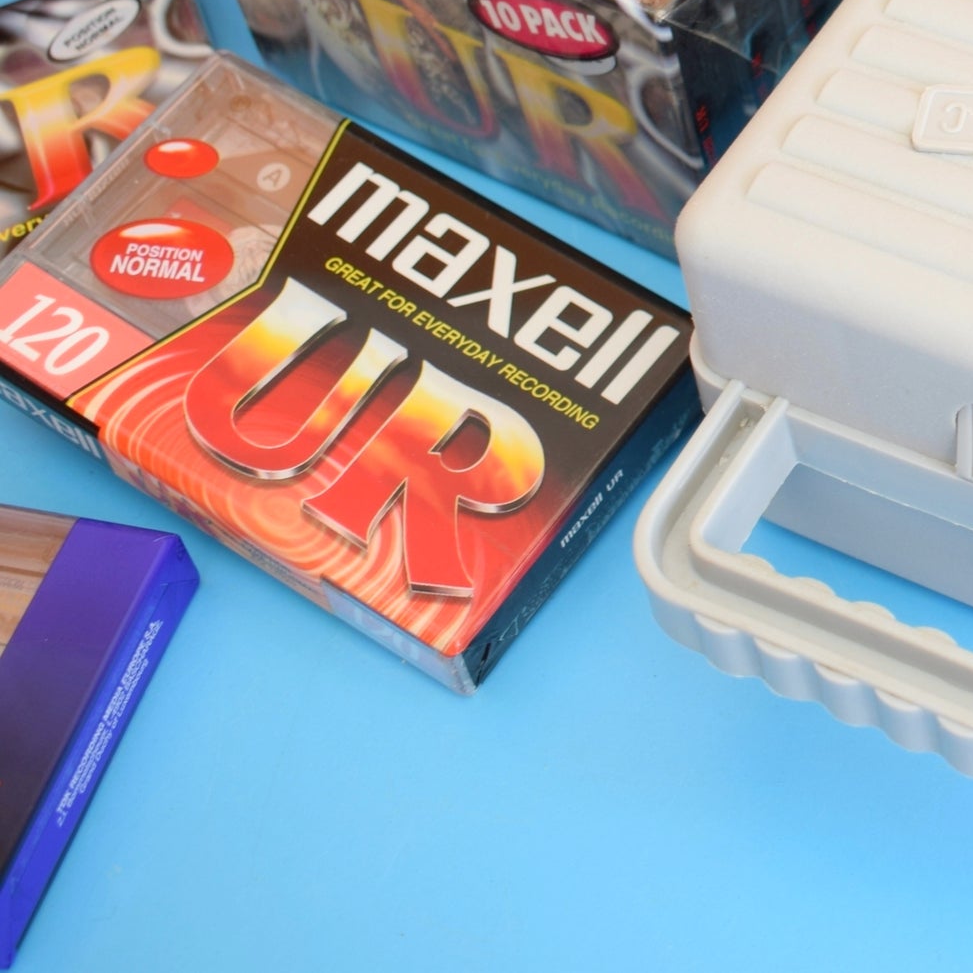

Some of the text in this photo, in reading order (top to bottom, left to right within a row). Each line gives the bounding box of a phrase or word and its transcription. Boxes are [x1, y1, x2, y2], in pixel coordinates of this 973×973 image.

[519, 3, 607, 45] PACK
[109, 254, 205, 282] NORMAL
[126, 243, 203, 262] POSITION
[307, 161, 680, 405] maxell
[0, 294, 110, 375] 120
[325, 257, 600, 430] GREAT FOR EVERYDAY RECORDING
[183, 276, 545, 598] UR
[560, 469, 624, 548] maxell UR
[57, 792, 73, 813] TDK
[69, 722, 105, 790] RECORDING
